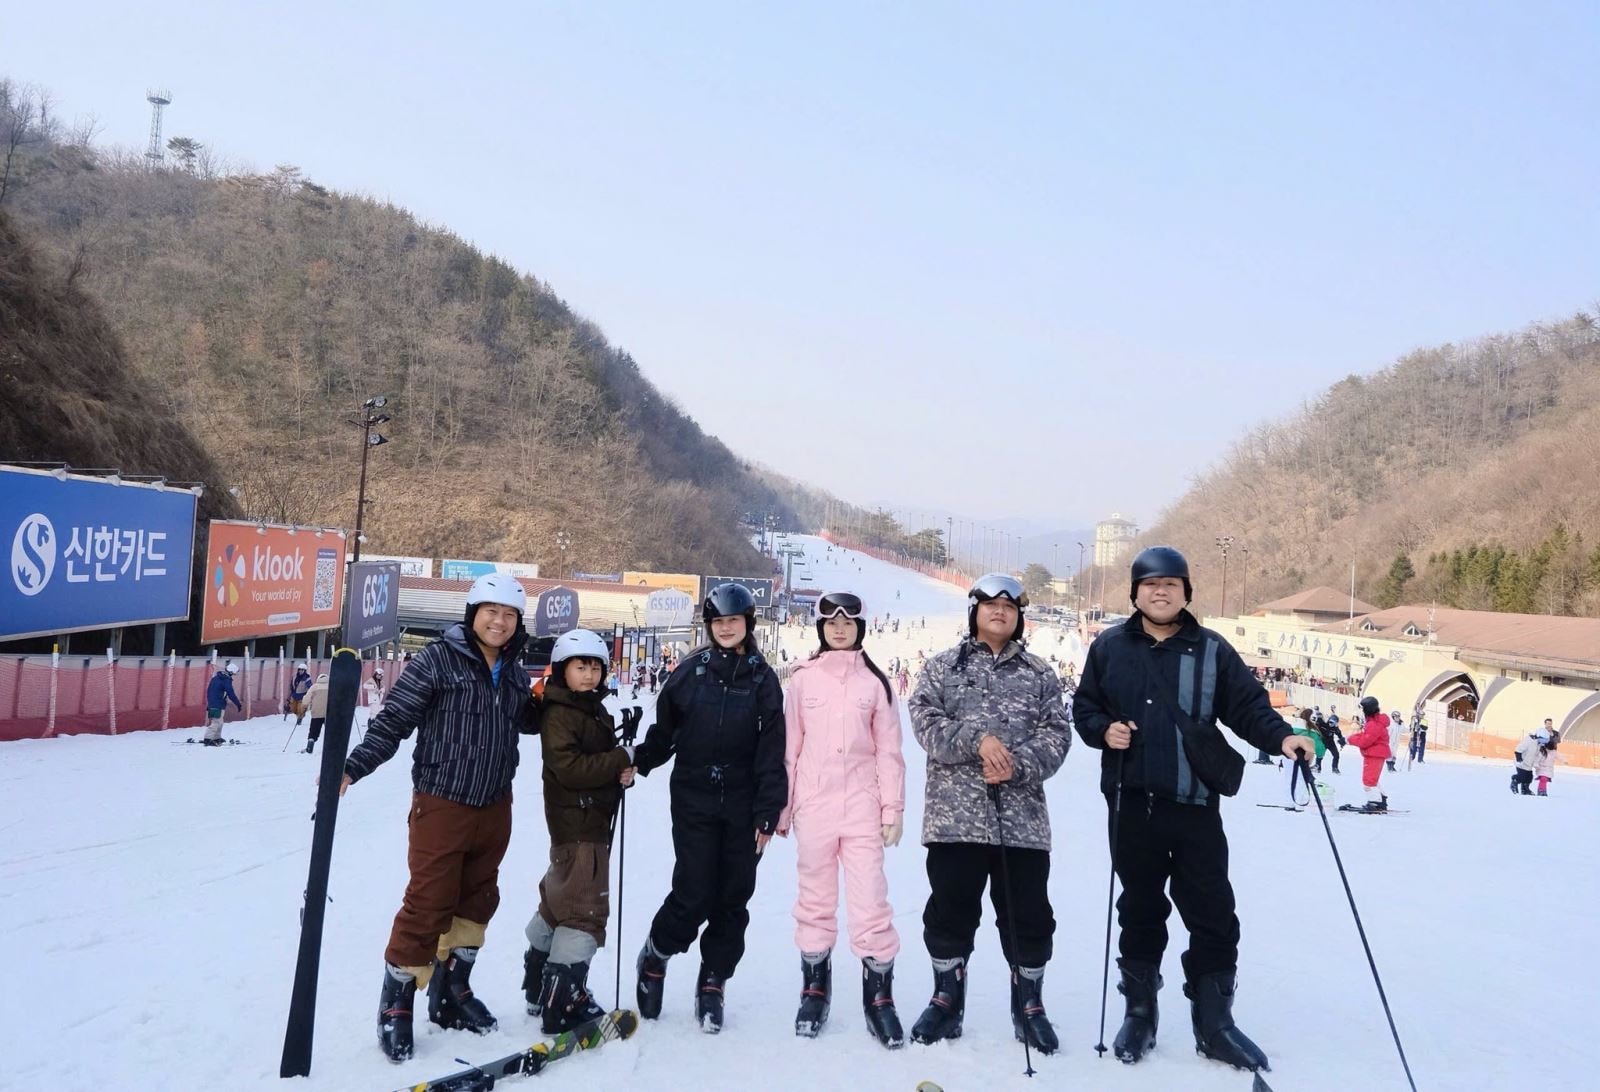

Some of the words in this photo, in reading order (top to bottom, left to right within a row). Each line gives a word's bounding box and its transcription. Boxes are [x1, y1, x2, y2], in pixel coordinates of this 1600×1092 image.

[64, 526, 166, 583] 신한카드
[253, 545, 304, 581] klook
[252, 590, 267, 602] Your
[267, 587, 285, 601] world
[286, 587, 292, 600] of
[292, 588, 302, 603] joy
[363, 574, 390, 618] GS25
[546, 595, 572, 619] GS25
[651, 597, 663, 611] GS
[664, 596, 689, 611] SHOP
